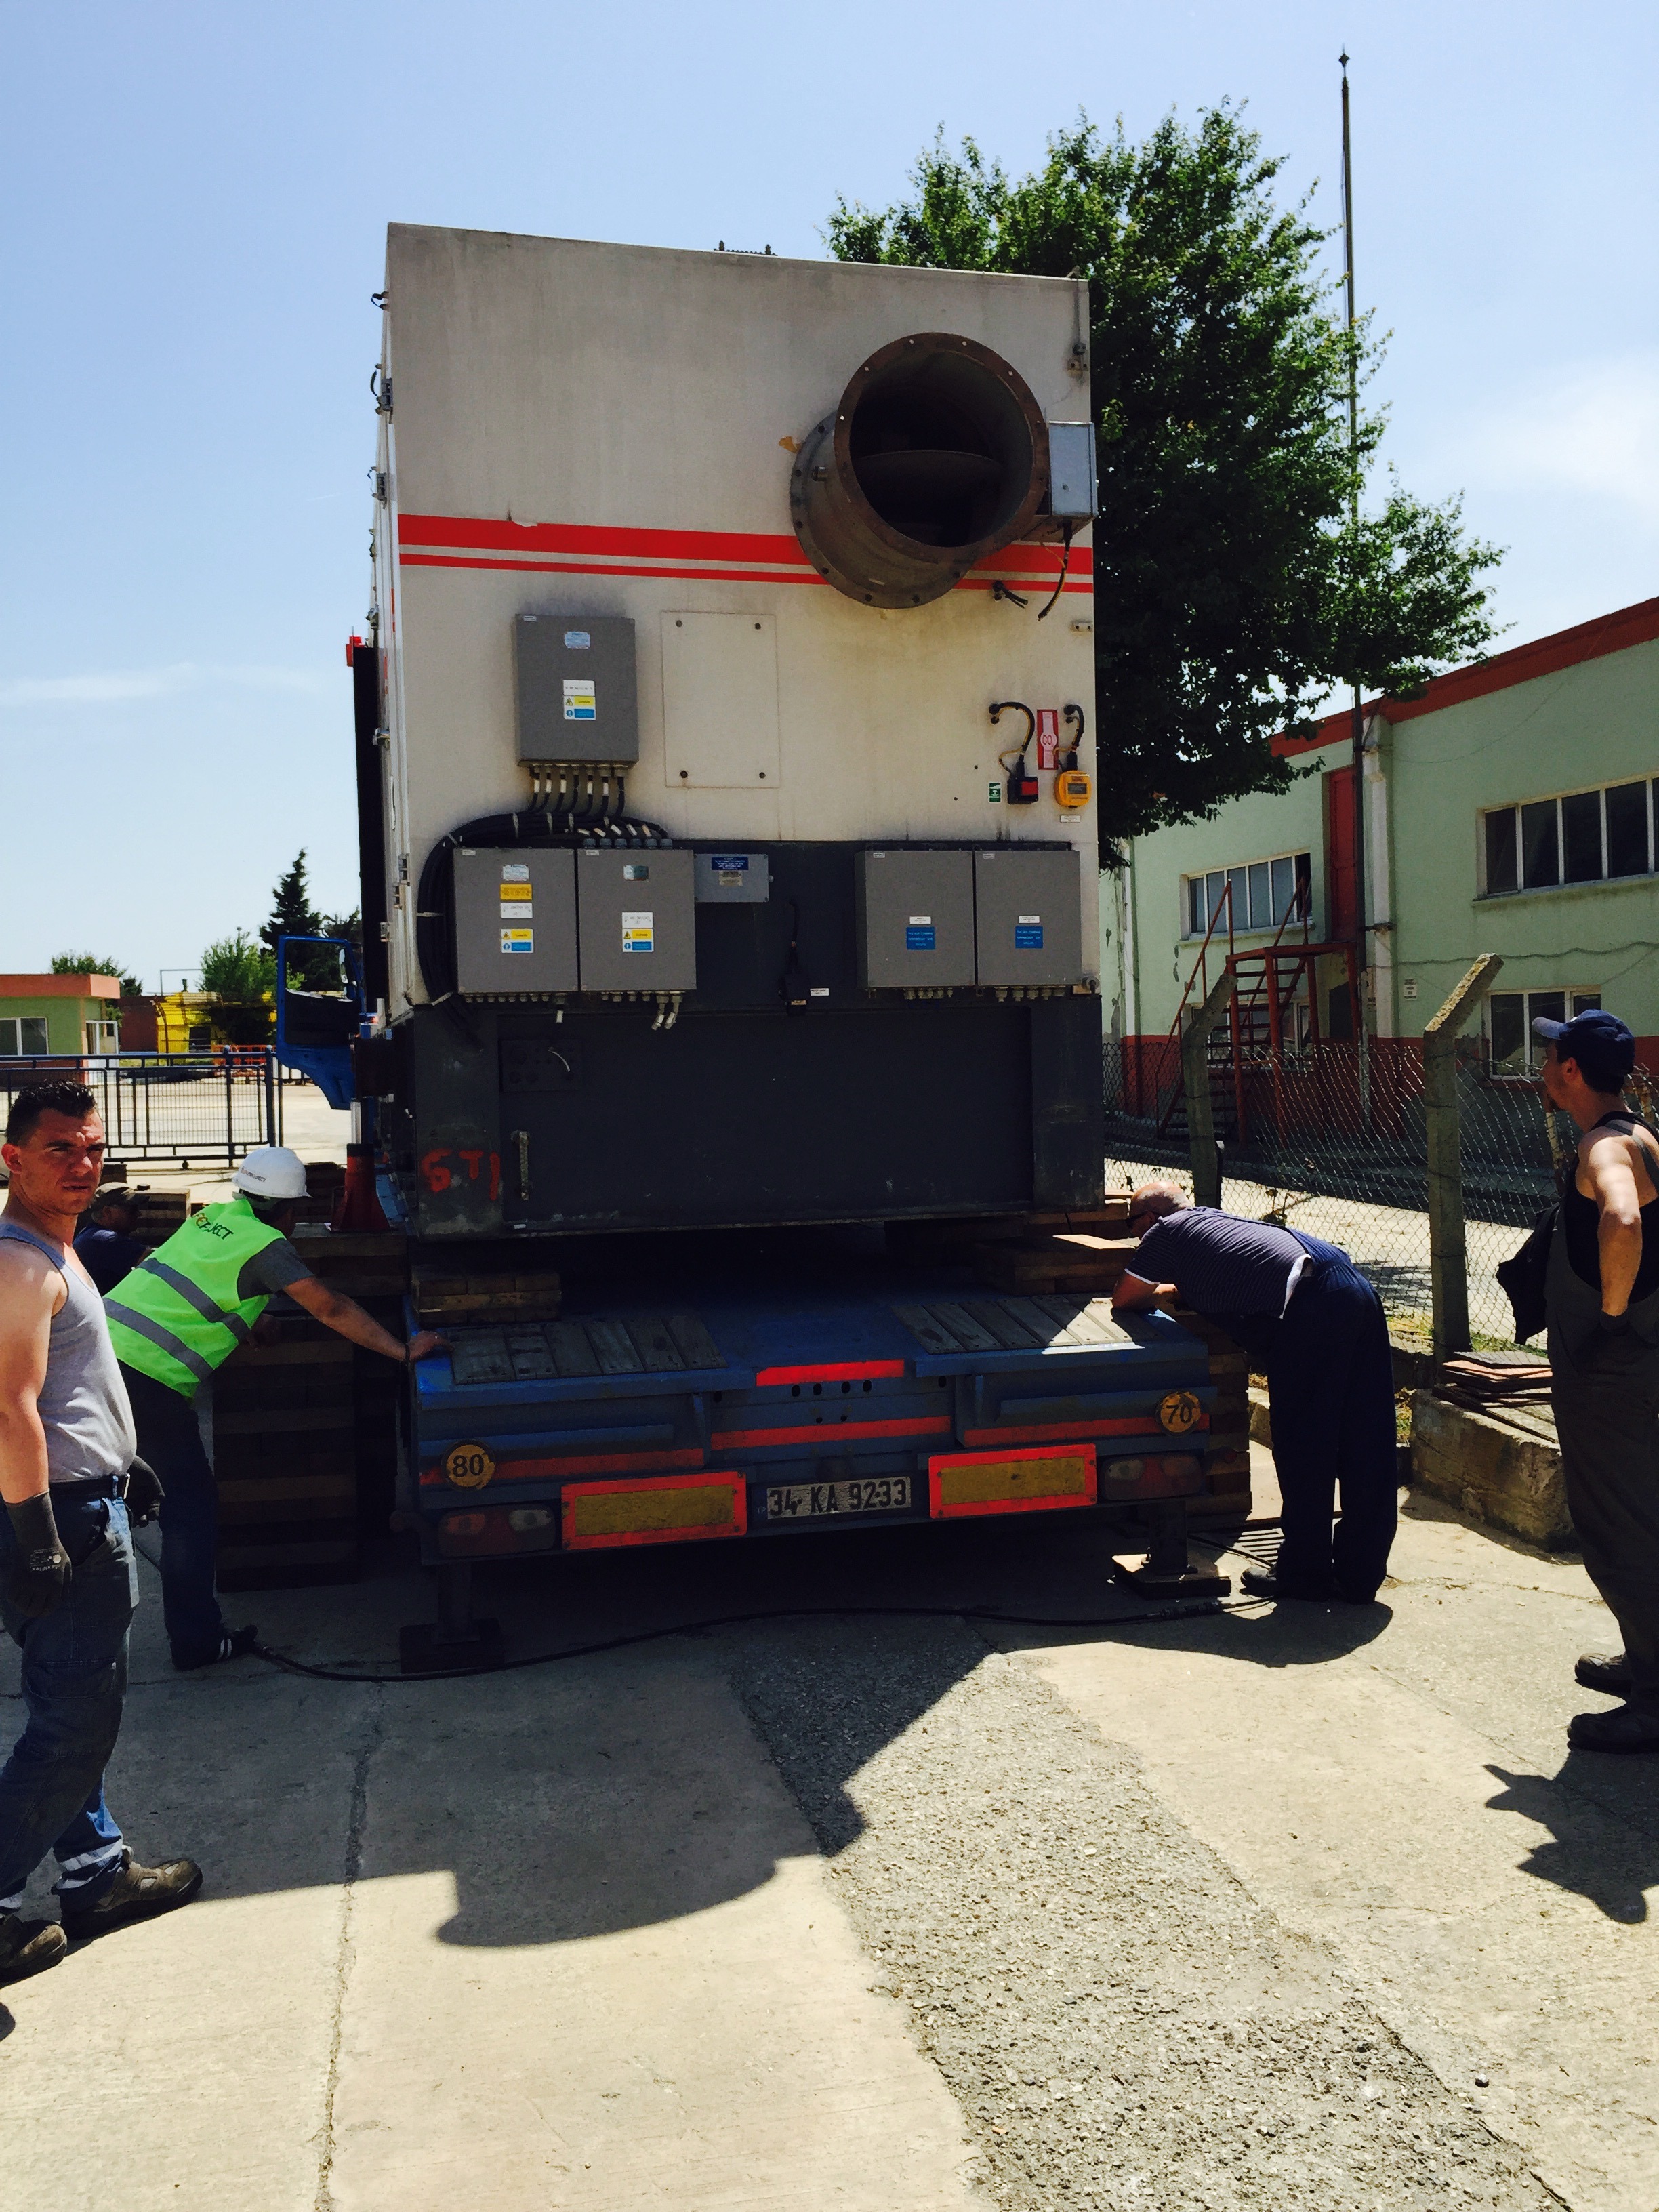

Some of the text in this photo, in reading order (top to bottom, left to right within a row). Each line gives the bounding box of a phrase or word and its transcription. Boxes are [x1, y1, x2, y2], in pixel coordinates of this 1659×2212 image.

[1166, 1404, 1192, 1424] 70
[453, 1454, 484, 1477] 80
[769, 1489, 798, 1516] 34
[811, 1484, 838, 1513] KA
[848, 1479, 907, 1510] 9233
